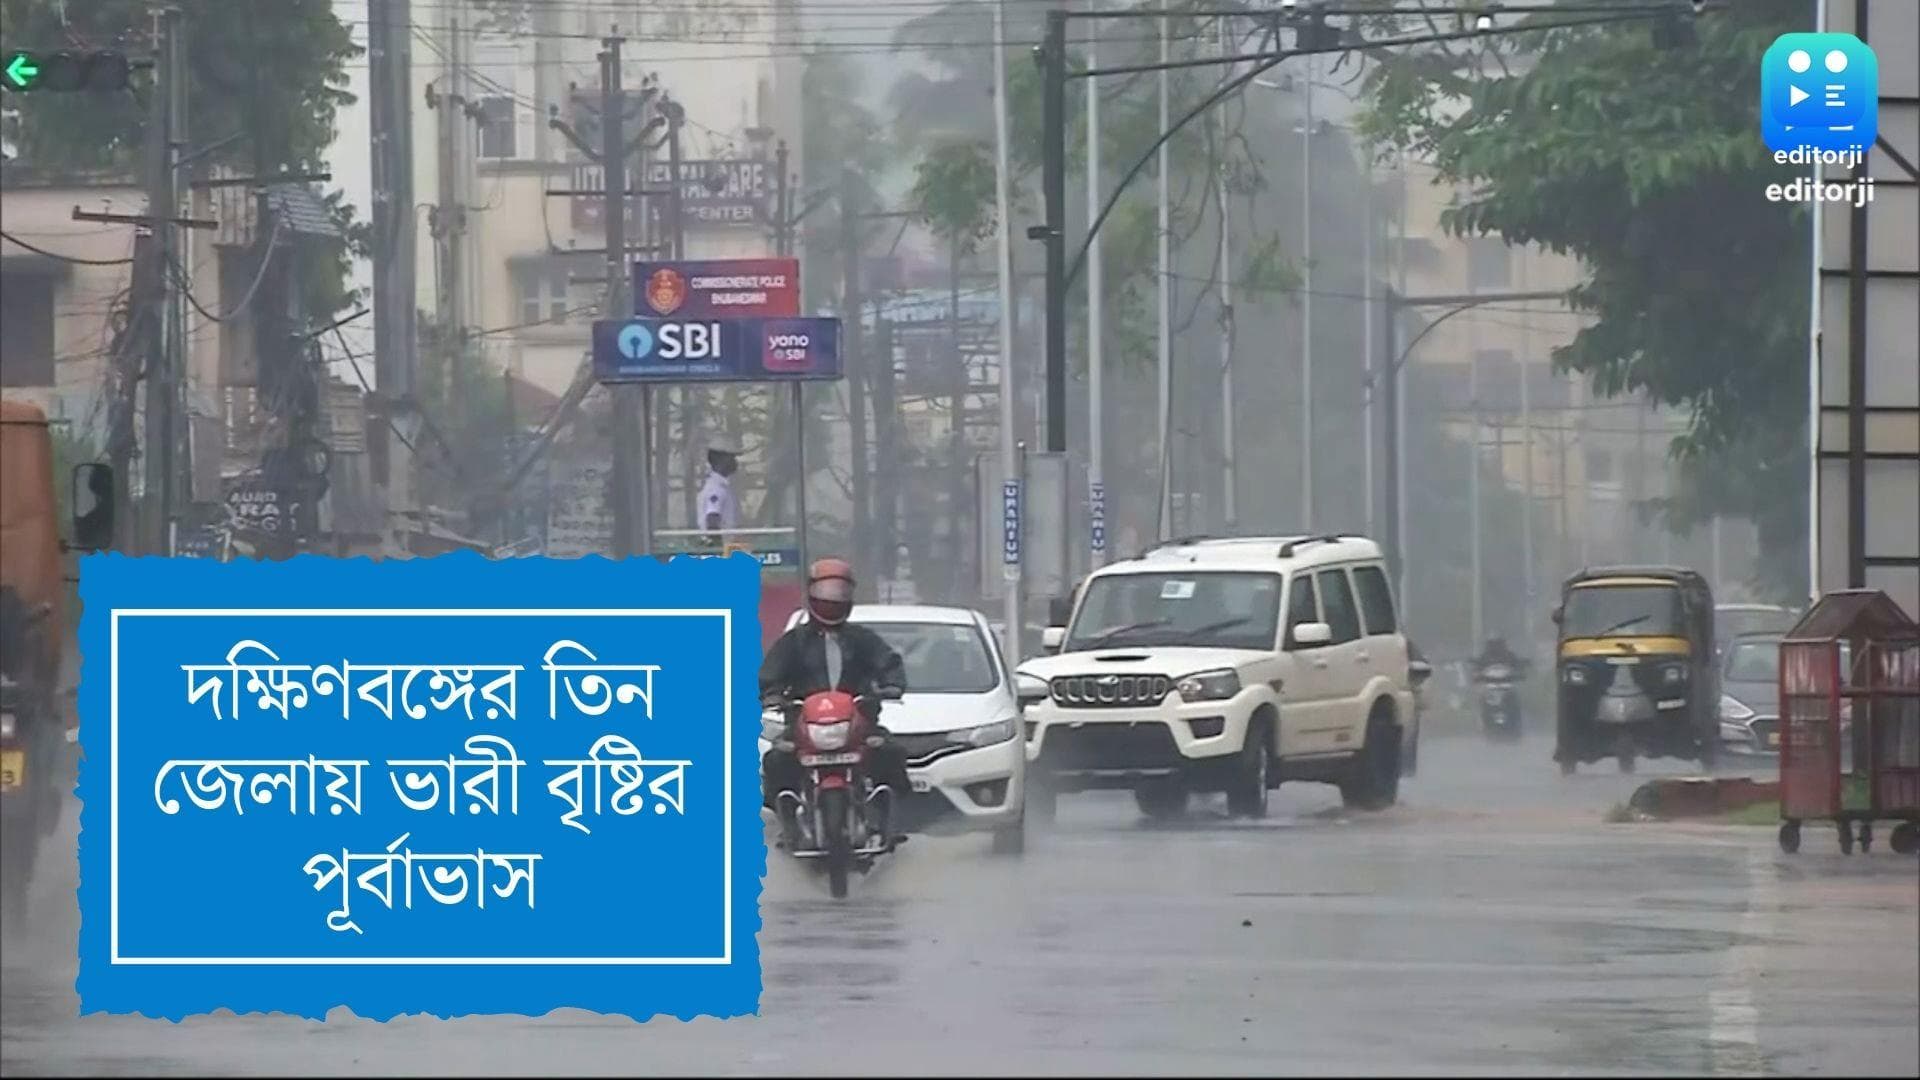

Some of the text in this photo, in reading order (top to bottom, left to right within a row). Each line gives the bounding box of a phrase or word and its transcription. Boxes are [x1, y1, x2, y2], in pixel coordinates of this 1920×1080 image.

[759, 274, 786, 288] POLICE
[658, 323, 721, 358] SBI
[769, 335, 809, 350] yono
[786, 349, 805, 361] SBI
[1005, 484, 1018, 561] URANIUM
